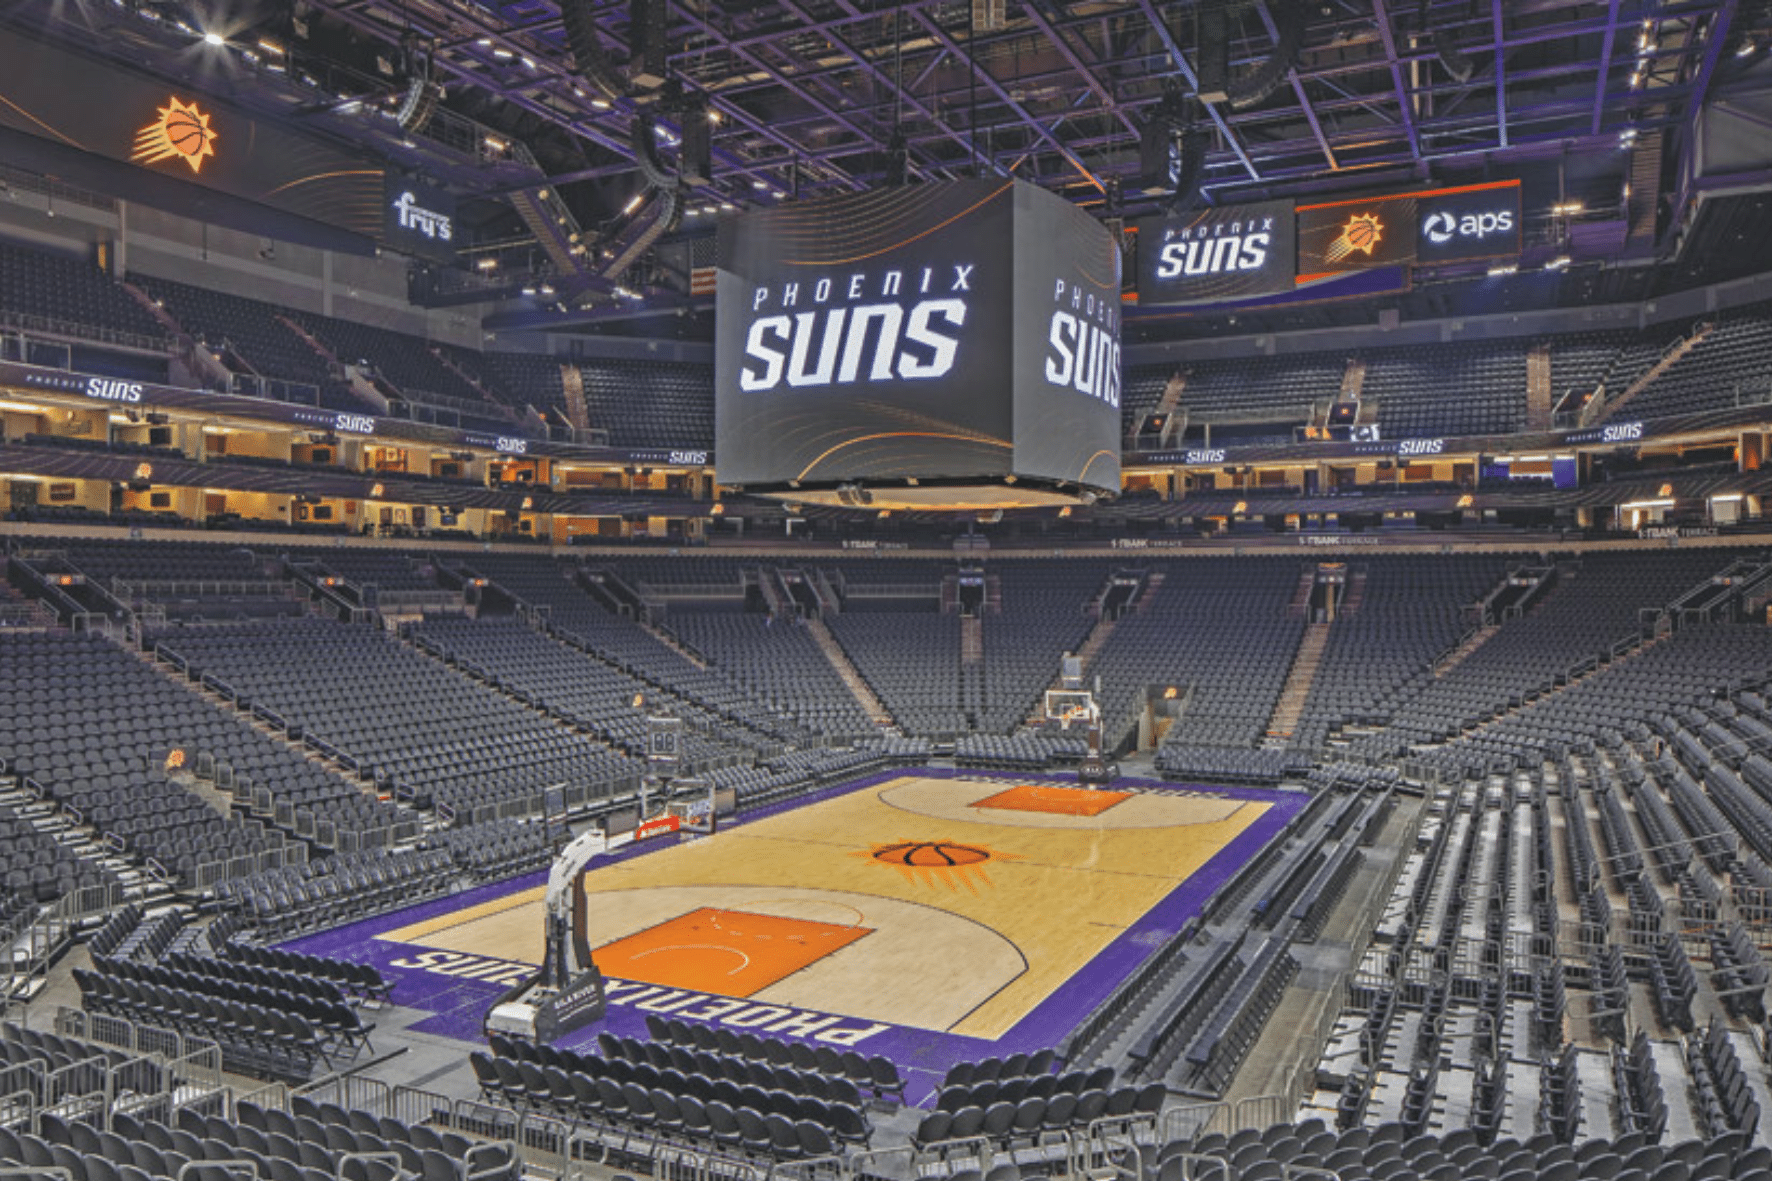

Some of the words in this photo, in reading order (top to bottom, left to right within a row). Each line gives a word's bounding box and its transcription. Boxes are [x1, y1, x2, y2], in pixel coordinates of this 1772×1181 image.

[1165, 218, 1273, 241] PHOENIX
[1460, 210, 1513, 239] aps
[1157, 233, 1270, 277] SUNS
[754, 264, 974, 310] PHOENIX
[1054, 278, 1120, 339] PHOENI
[740, 298, 967, 391] SUNS
[1045, 310, 1120, 408] SUNS
[86, 378, 142, 401] SUNS
[336, 409, 375, 433] SUNS
[1603, 421, 1642, 442] SUNS
[1398, 439, 1443, 453] SUNS
[389, 951, 541, 988] UNS
